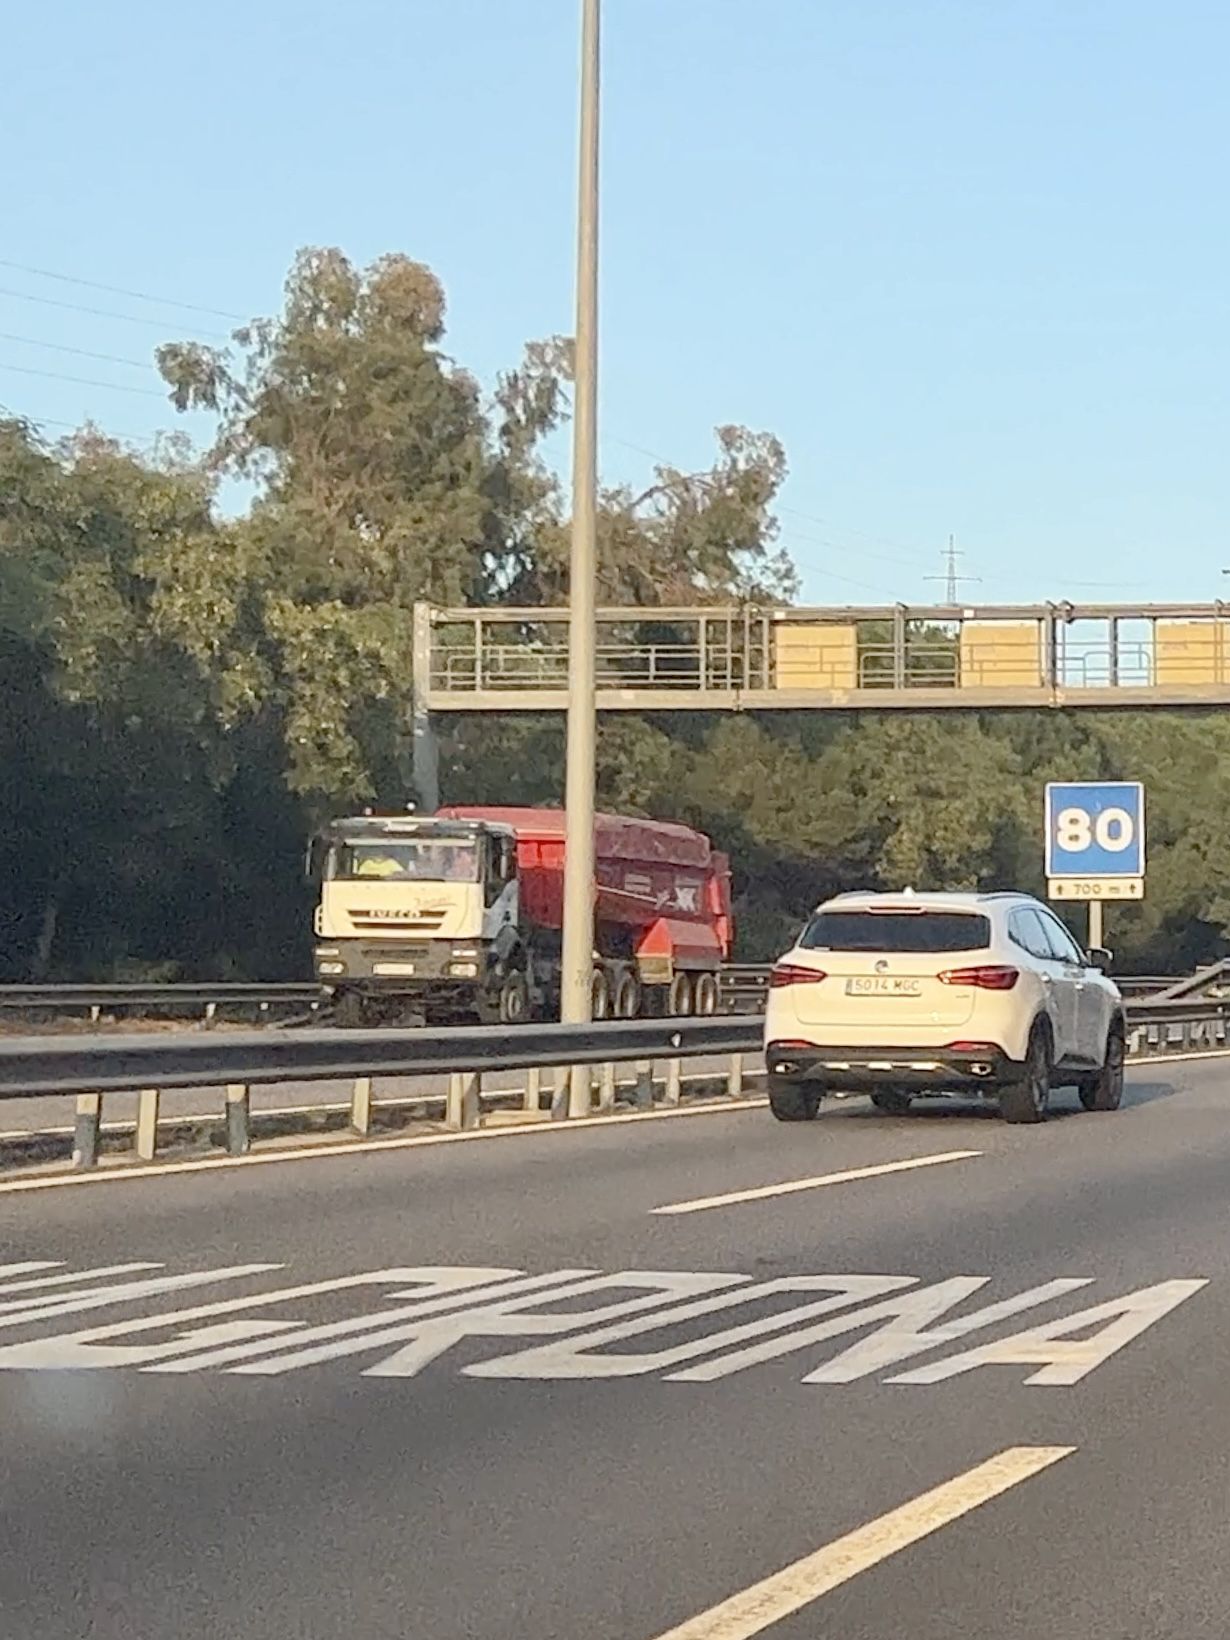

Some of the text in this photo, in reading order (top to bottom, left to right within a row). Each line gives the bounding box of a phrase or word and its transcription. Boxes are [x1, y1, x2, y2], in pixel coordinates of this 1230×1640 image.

[1057, 807, 1134, 853] 80
[1073, 884, 1102, 895] 700
[0, 1266, 1211, 1387] GIRONA
